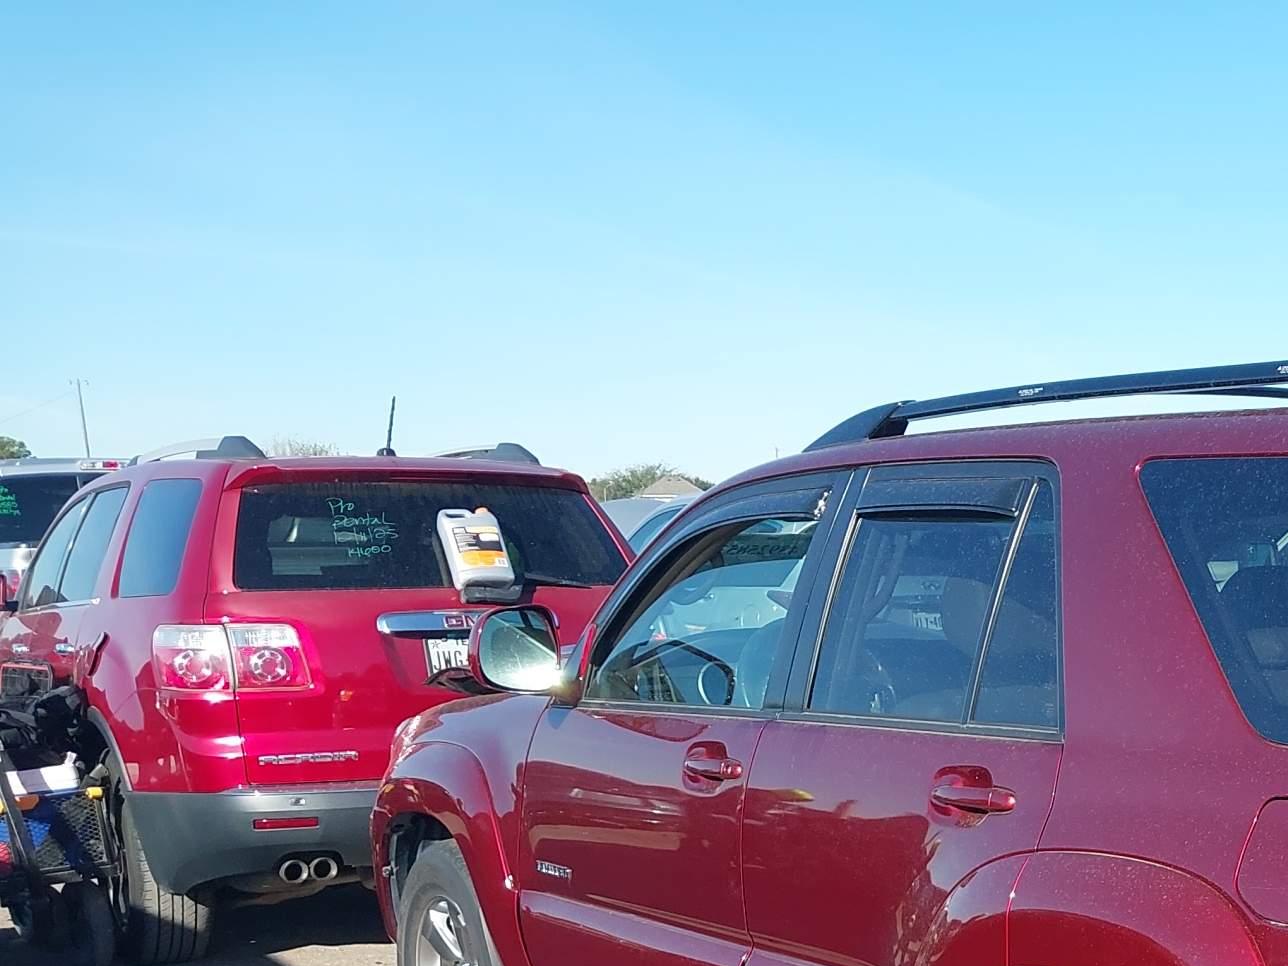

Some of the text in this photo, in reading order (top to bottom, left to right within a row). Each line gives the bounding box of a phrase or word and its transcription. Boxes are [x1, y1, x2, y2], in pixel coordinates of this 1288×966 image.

[325, 497, 355, 516] Pro
[443, 614, 480, 630] GM
[258, 750, 359, 766] ACADIA
